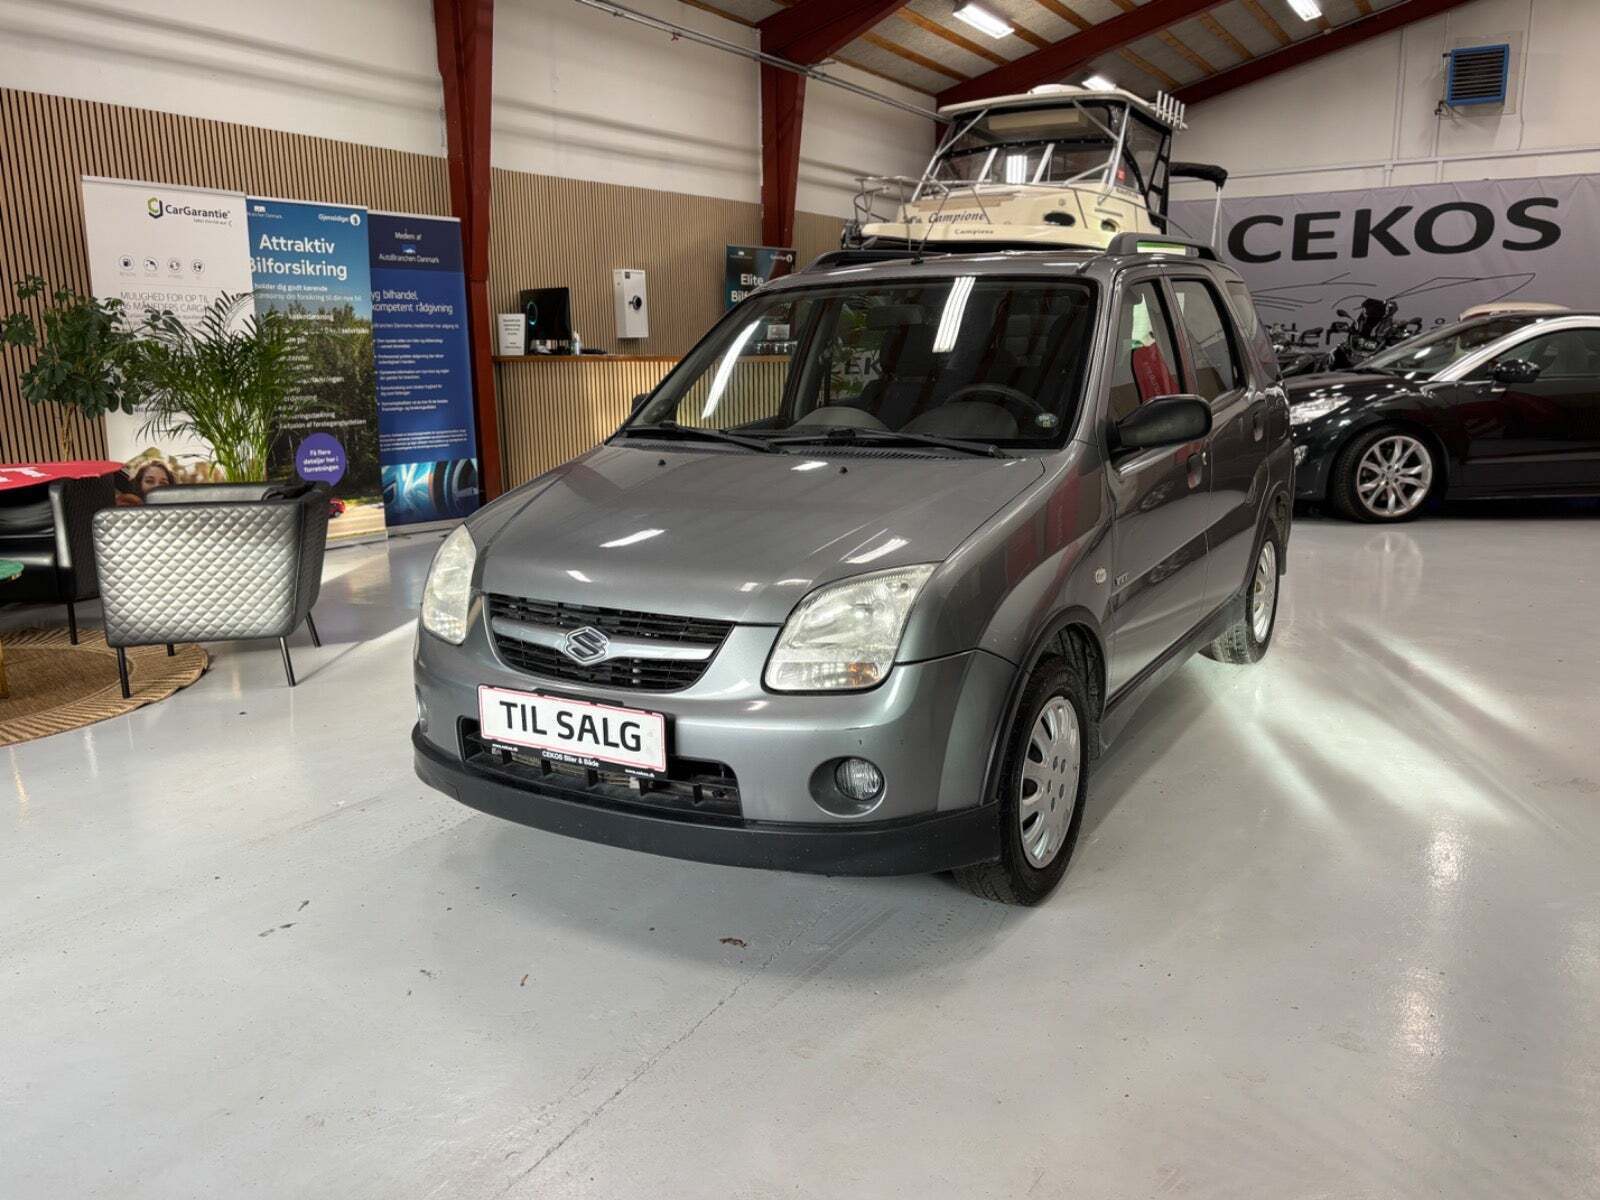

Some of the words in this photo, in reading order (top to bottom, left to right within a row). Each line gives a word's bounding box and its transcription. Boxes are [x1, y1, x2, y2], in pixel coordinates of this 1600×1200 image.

[165, 204, 229, 219] CarGarantie
[928, 211, 986, 224] Campione
[1227, 196, 1562, 263] CEKOS
[259, 233, 335, 254] Attraktiv
[740, 273, 764, 286] Elite
[499, 699, 548, 736] TIL
[556, 710, 642, 753] SALG
